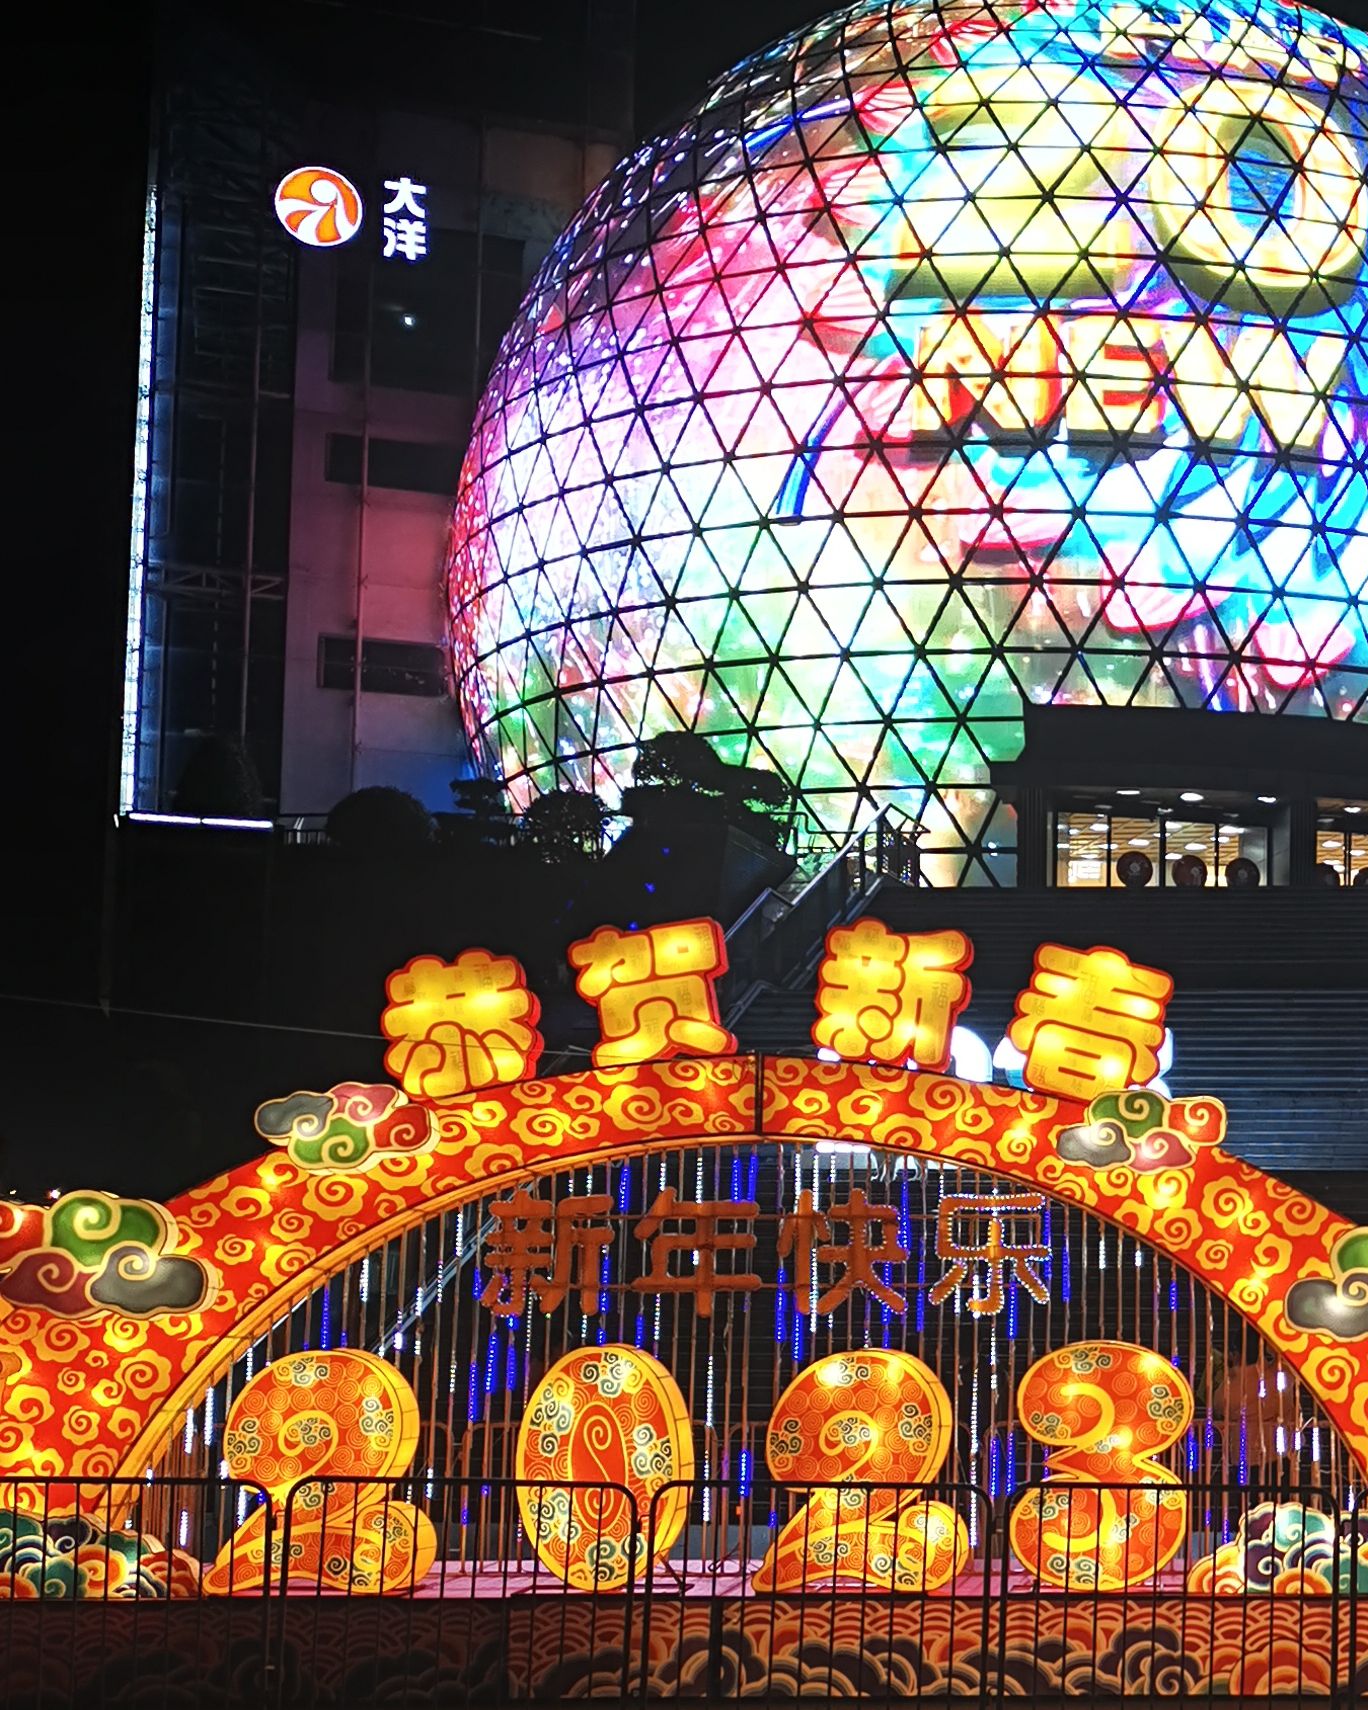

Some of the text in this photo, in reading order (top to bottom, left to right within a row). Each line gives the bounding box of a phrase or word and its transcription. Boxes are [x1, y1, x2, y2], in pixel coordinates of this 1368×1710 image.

[383, 177, 427, 260] 大洋
[911, 315, 1352, 450] NEW
[381, 917, 1174, 1100] 恭贺新春
[481, 1187, 1052, 1320] 新年快乐
[202, 1339, 1196, 1596] 2023
